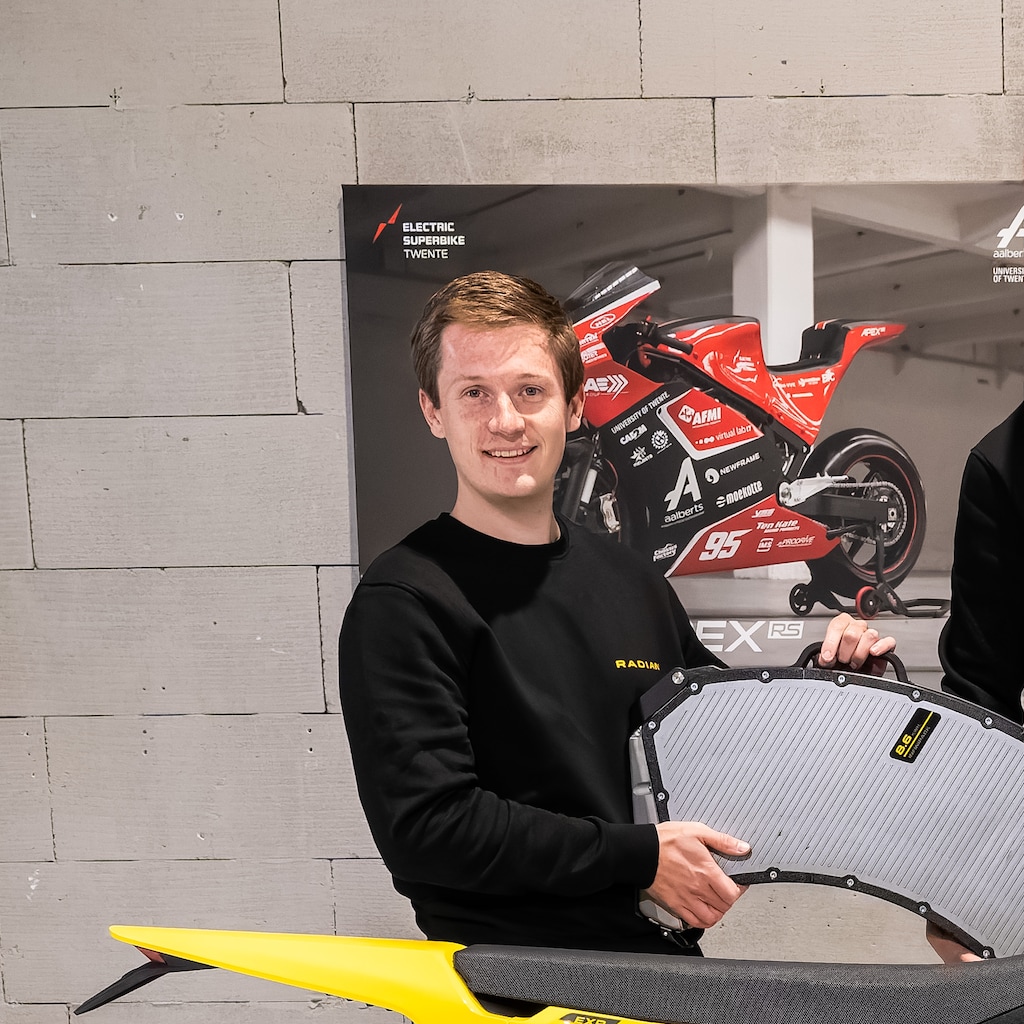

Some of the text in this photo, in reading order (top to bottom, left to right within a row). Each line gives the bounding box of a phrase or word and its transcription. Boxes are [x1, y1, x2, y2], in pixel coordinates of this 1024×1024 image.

[402, 222, 455, 232] ELECTRIC
[403, 235, 466, 246] SUPERBIKE
[403, 248, 449, 259] TWENTE
[993, 275, 1002, 283] OF
[610, 411, 643, 435] UNIVERSITY
[641, 404, 649, 415] OF
[692, 406, 722, 426] AFMI
[715, 428, 737, 441] virtual
[720, 452, 761, 476] NEWFRAME
[664, 503, 705, 524] aalberts
[756, 521, 775, 530] Ten
[774, 519, 799, 529] Kate
[698, 528, 753, 561] 95
[690, 621, 802, 653] EX RS
[615, 659, 661, 671] RADIAN
[895, 734, 913, 756] 8.6
